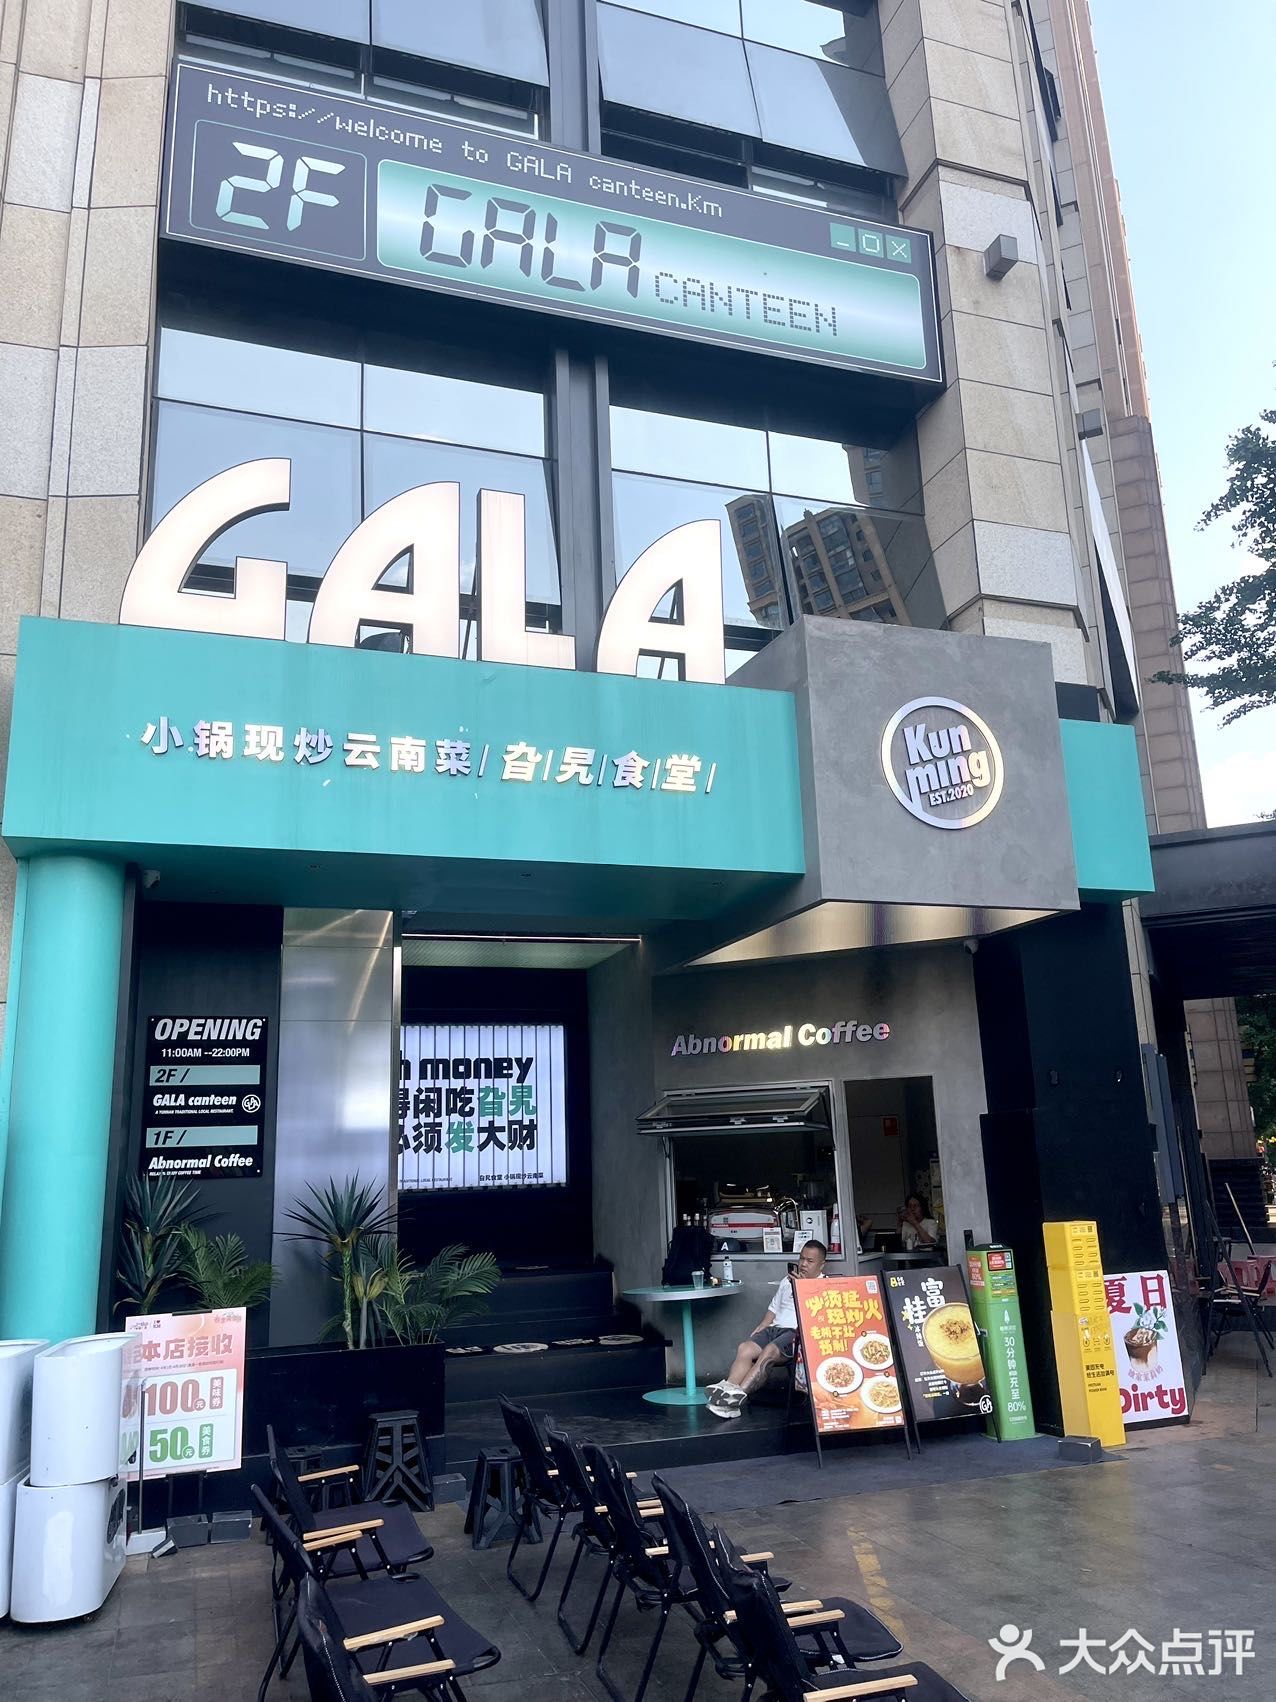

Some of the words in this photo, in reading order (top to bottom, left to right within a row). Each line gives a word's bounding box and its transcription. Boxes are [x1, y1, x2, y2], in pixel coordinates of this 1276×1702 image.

[207, 83, 443, 154] https://welcome
[461, 140, 489, 164] to
[506, 151, 573, 184] GALA
[215, 141, 346, 232] 2F
[419, 183, 642, 299] GALA
[654, 271, 838, 337] CANTEEN
[119, 457, 727, 685] GALA
[903, 723, 972, 765] Kun
[905, 750, 991, 808] ming
[928, 783, 974, 807] EST.2020
[154, 1018, 263, 1041] OPENING
[670, 1024, 793, 1057] Abnormal
[797, 1020, 891, 1047] Coffee
[161, 1048, 202, 1058] 11:00AM
[155, 1068, 178, 1083] 2F
[419, 1056, 534, 1084] money
[152, 1093, 185, 1106] GALA
[188, 1094, 237, 1106] canteen
[153, 1130, 175, 1146] 1F
[148, 1154, 213, 1170] Abnormal
[214, 1153, 254, 1168] Coffee
[142, 1333, 233, 1362] 本店接收
